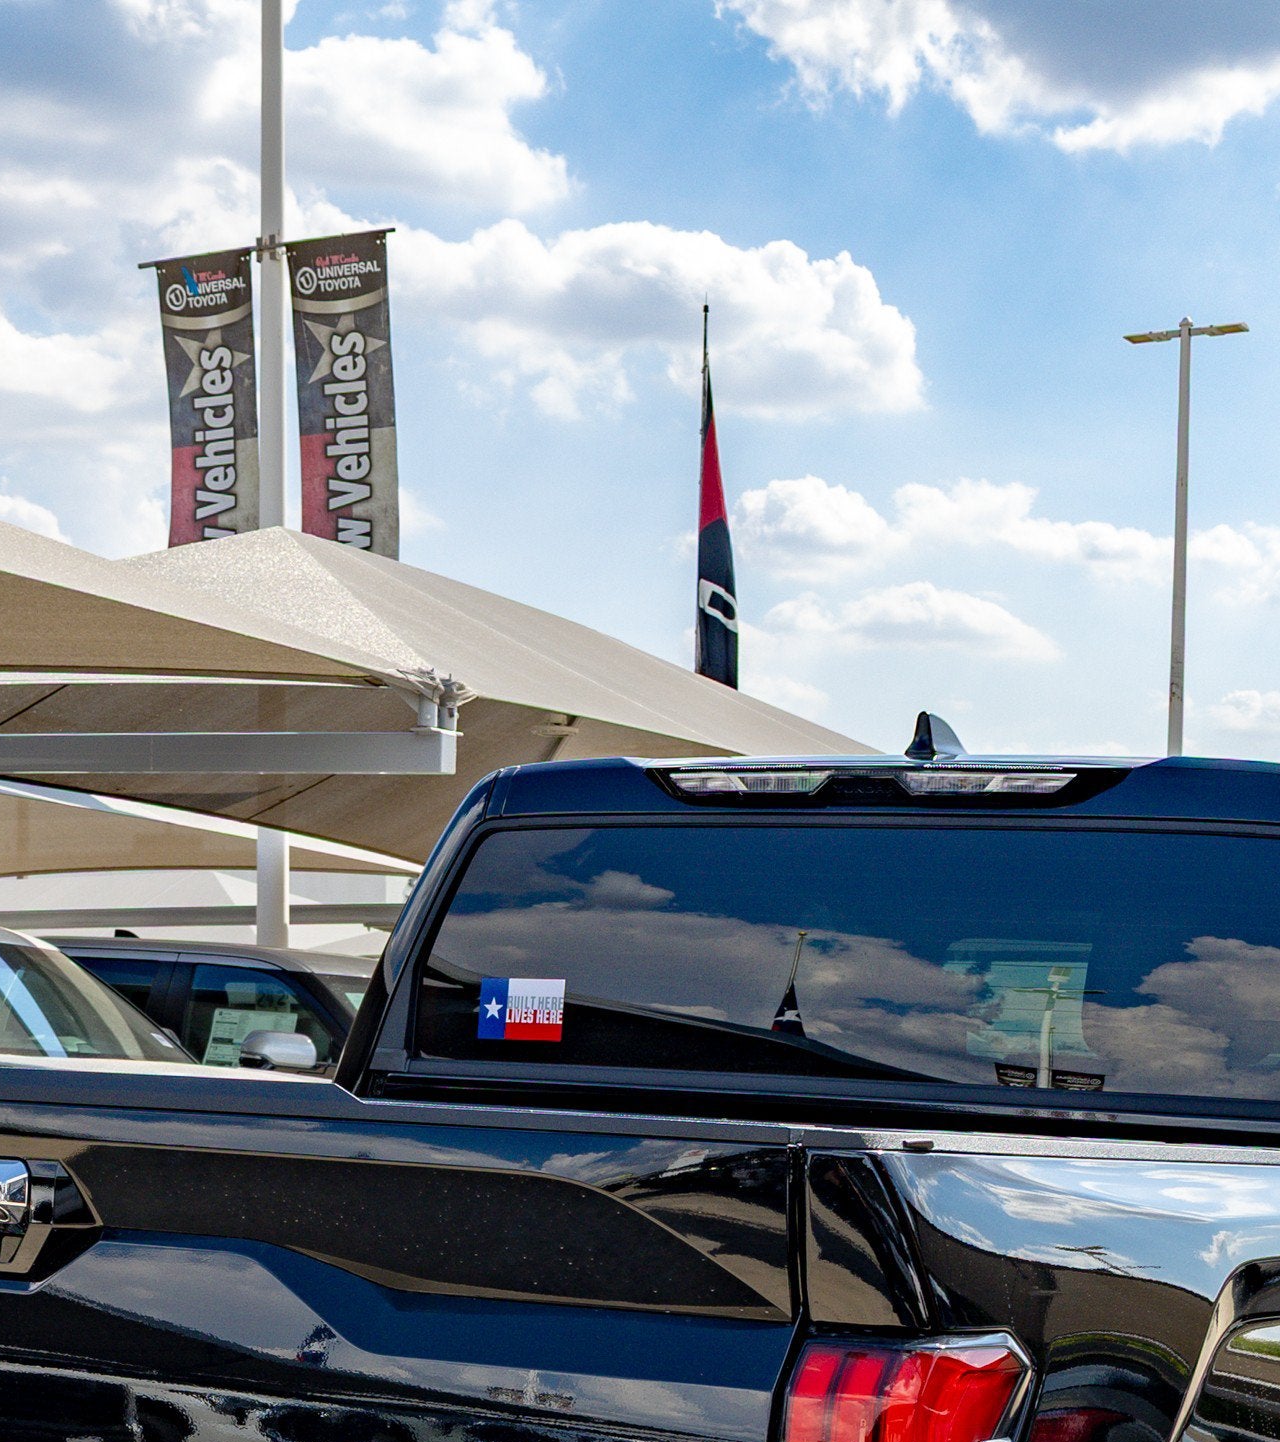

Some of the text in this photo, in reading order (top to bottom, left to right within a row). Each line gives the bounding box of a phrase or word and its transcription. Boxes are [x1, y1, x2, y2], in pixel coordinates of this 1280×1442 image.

[317, 260, 381, 279] UNIVERSAL
[318, 276, 361, 292] TOYOTA
[187, 293, 228, 308] TOYOTA
[324, 331, 372, 511] Vehicles
[194, 345, 237, 521] Vehicles
[507, 996, 564, 1010] BUILT HERE
[506, 1009, 563, 1024] LIVES HERE
